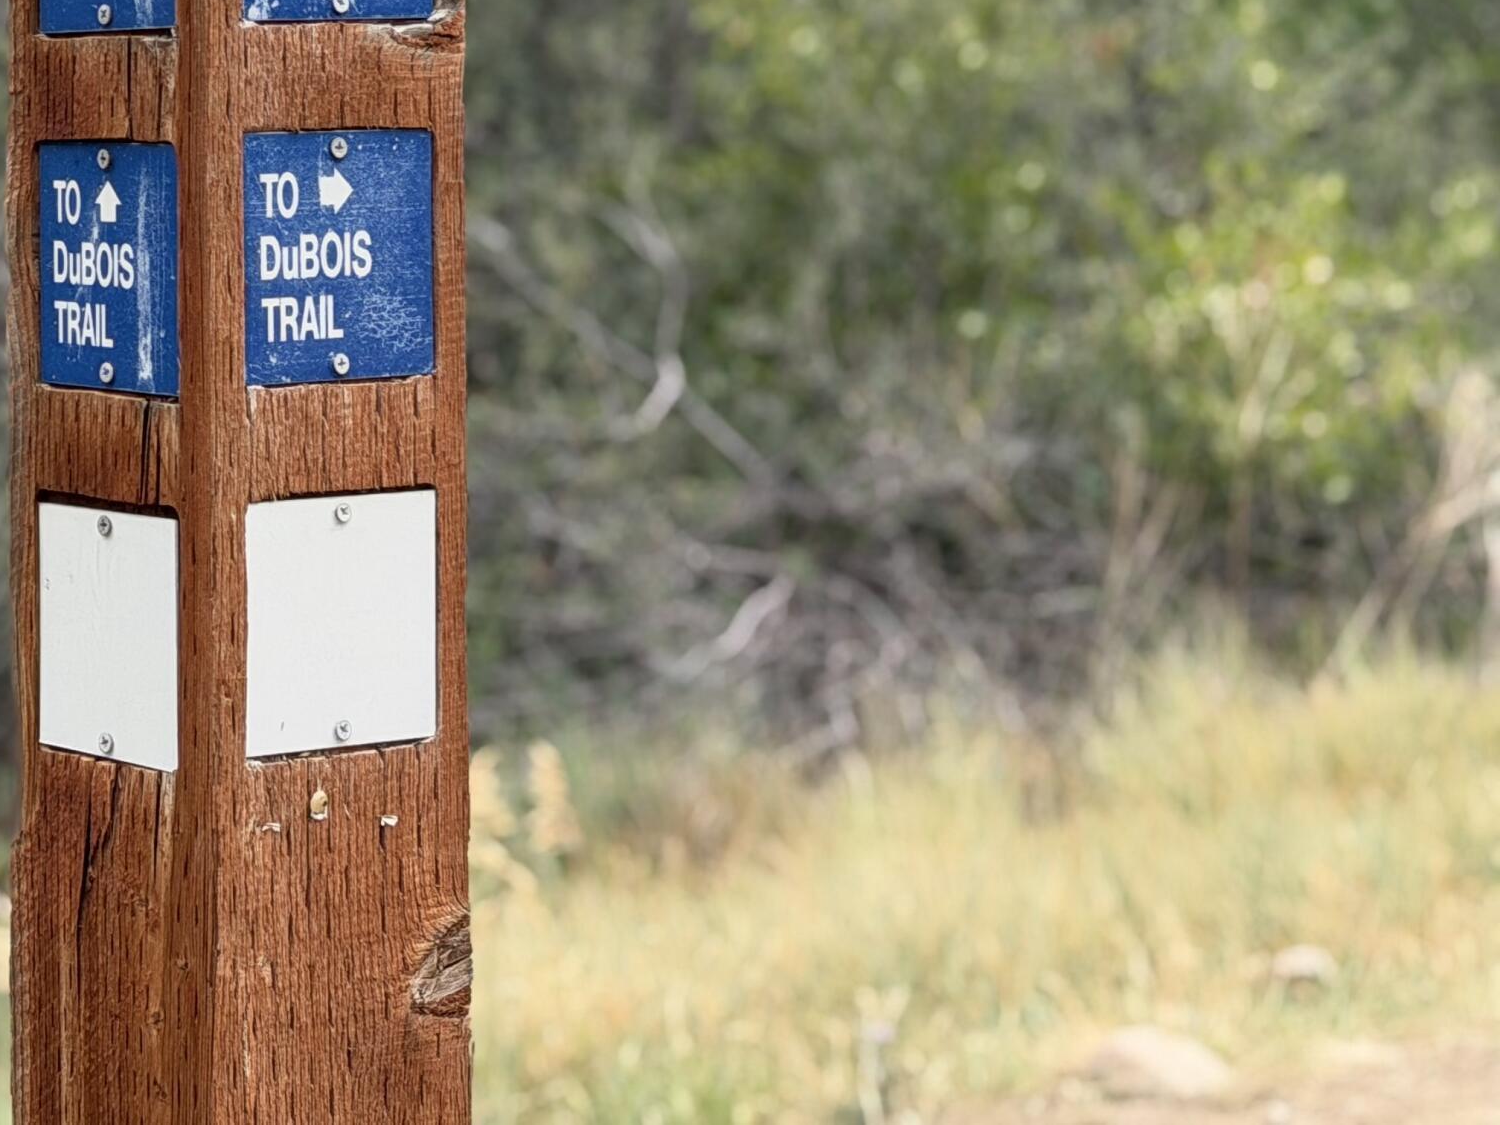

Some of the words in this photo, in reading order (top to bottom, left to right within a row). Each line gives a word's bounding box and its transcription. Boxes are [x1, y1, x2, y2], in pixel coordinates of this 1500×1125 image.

[53, 179, 81, 225] TO
[260, 171, 299, 219] TO
[53, 240, 135, 289] DuBOIS
[260, 230, 372, 281] DuBOIS
[54, 300, 114, 348] TRAIL
[261, 295, 344, 343] TRAIL
